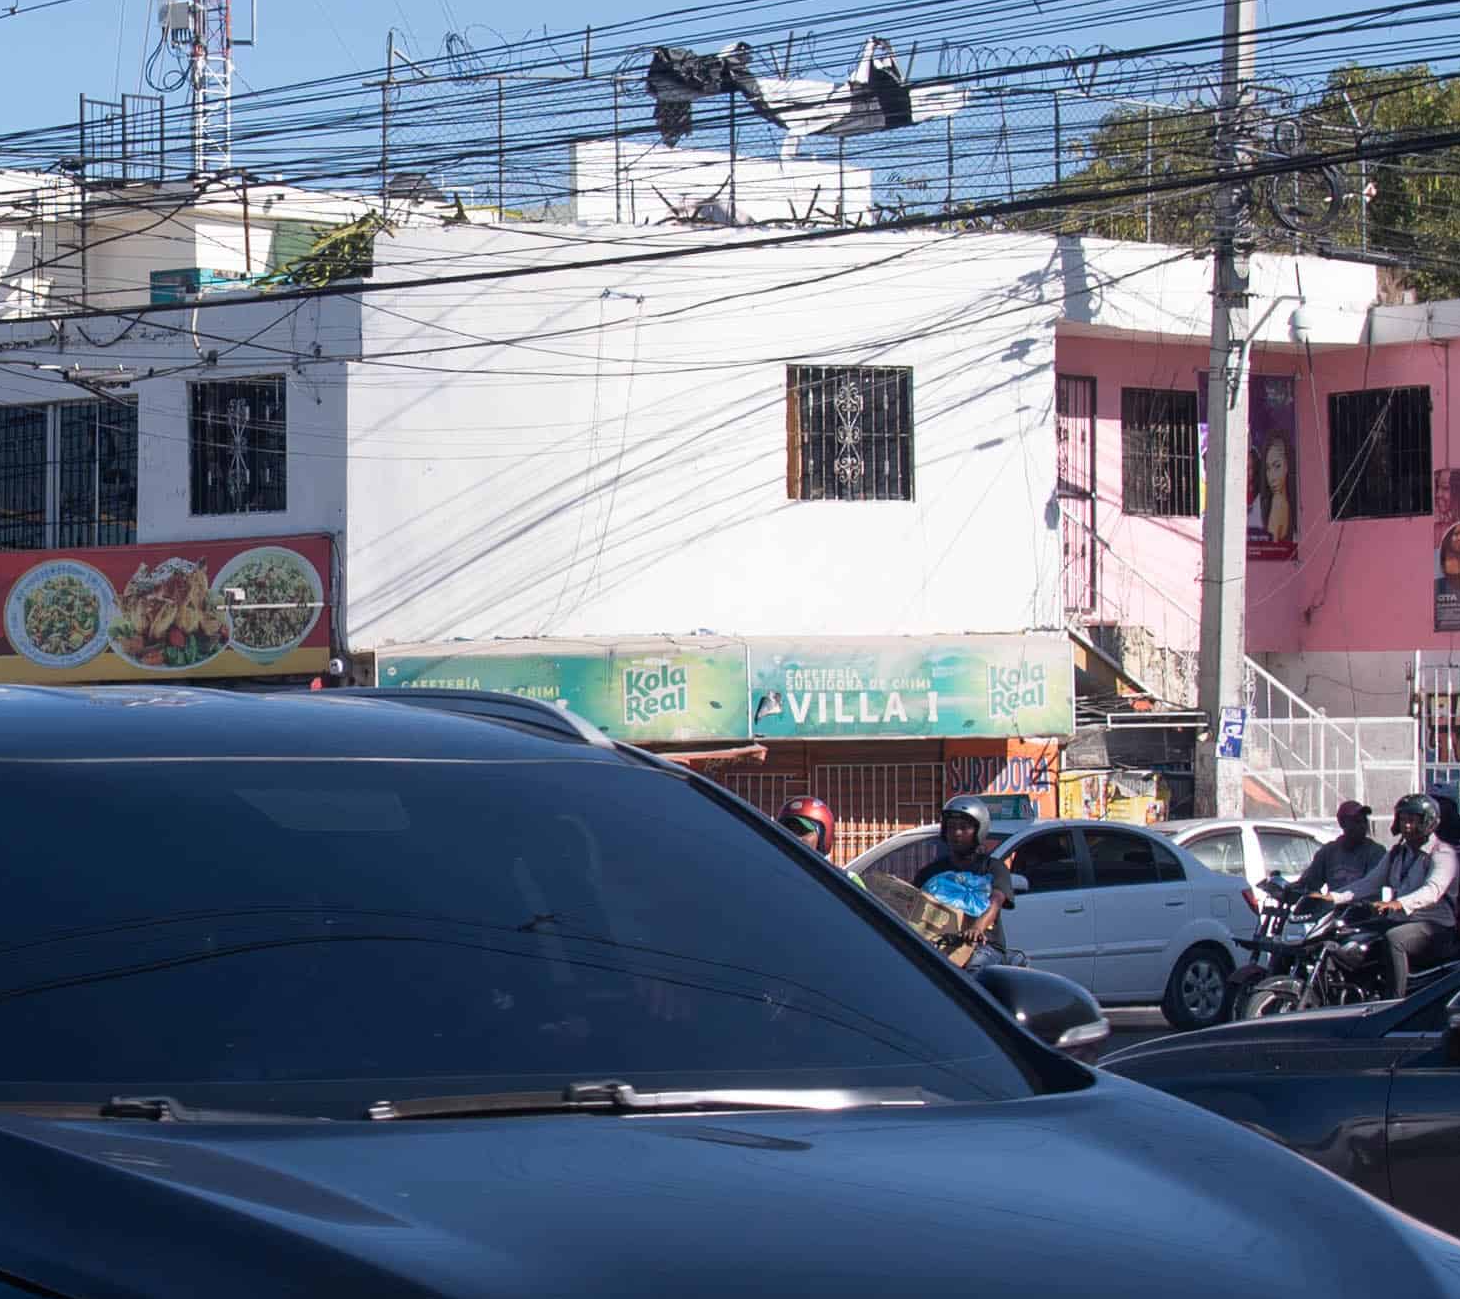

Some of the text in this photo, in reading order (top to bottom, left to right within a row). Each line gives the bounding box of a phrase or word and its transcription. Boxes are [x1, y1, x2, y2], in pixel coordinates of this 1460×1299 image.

[625, 664, 687, 698] Kola
[870, 679, 885, 691] DE
[889, 679, 931, 691] CHIMI
[988, 661, 1046, 692] Kola
[626, 687, 687, 724] Real
[786, 691, 908, 723] VILLA
[989, 686, 1046, 718] Real
[950, 755, 1052, 795] SURTIDORA
